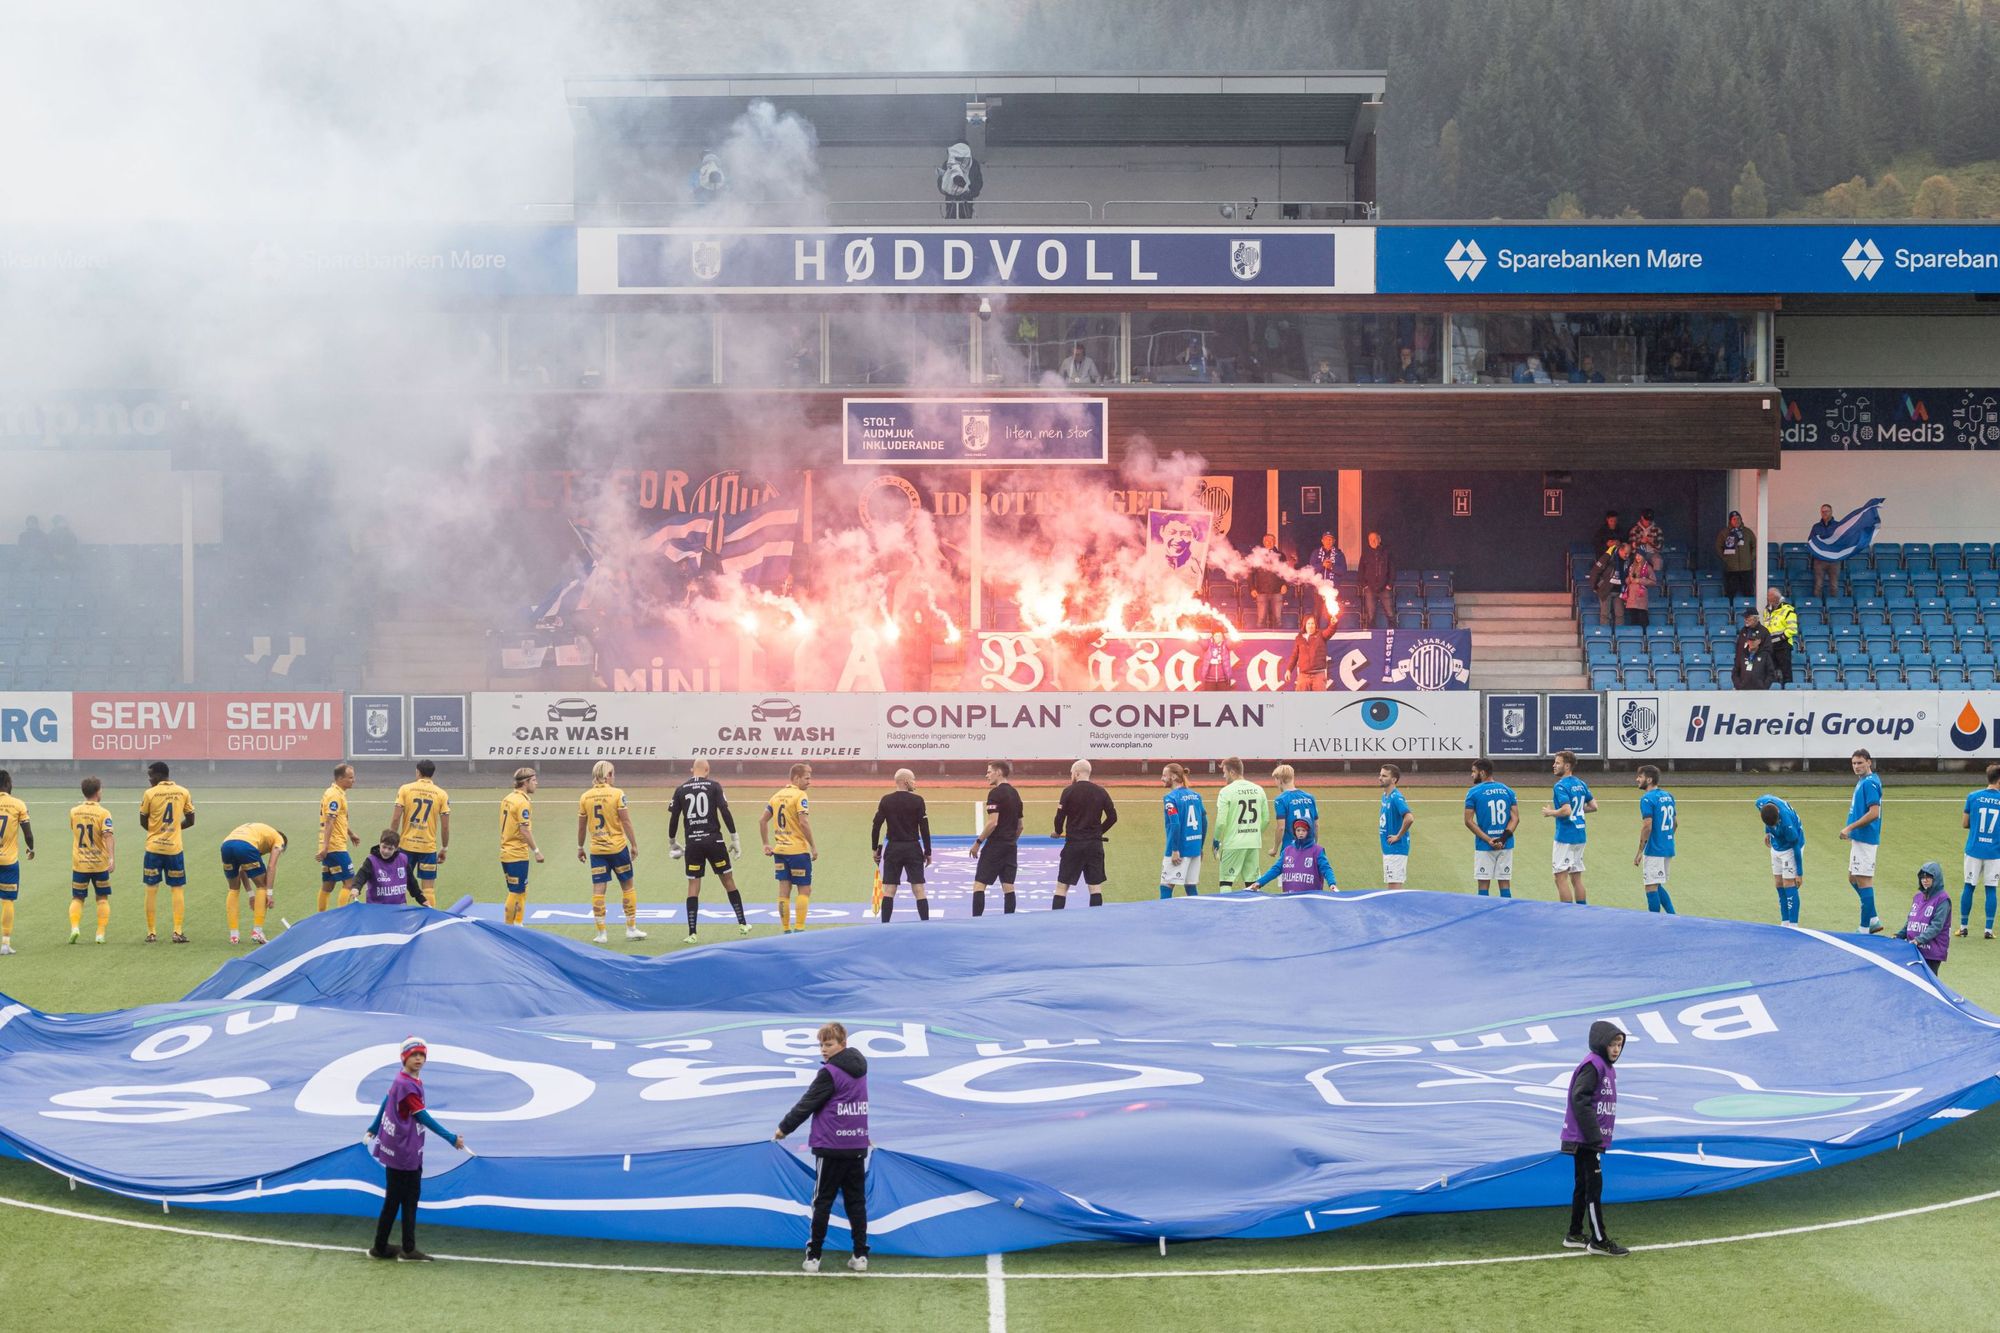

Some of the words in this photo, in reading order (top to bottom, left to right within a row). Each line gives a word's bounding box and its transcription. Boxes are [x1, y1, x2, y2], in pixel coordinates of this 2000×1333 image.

[449, 249, 507, 269] Møre
[794, 237, 1159, 283] HØDDVOLL
[1496, 247, 1641, 272] Sparebanken
[1646, 248, 1703, 269] Møre
[862, 416, 896, 427] STOLT
[1067, 425, 1093, 439] stor
[862, 428, 915, 438] AUDMJUK
[1877, 423, 1945, 443] Medi3
[862, 440, 945, 450] INKLUDERANDE
[90, 701, 196, 730] SERVI
[225, 701, 332, 730] SERVI
[1713, 712, 1814, 736] Hareid
[515, 726, 558, 741] CAR
[568, 726, 629, 741] WASH
[717, 726, 762, 742] CAR
[774, 726, 835, 742] WASH
[886, 732, 929, 741] Rådgivende
[930, 732, 966, 741] ingeniører
[968, 732, 987, 742] bygg
[1089, 731, 1132, 740] Rådgivende
[1133, 731, 1169, 740] ingeniører
[1171, 731, 1189, 741] bygg
[1292, 737, 1386, 752] HAVBLIKK
[1391, 736, 1464, 752] OPTIKK
[488, 746, 590, 756] PROFESJONELL
[597, 746, 657, 756] BILPLEIE
[691, 747, 794, 757] PROFESJONELL
[801, 747, 862, 757] BILPLEIE
[886, 741, 950, 751] www.conplan.no
[1089, 740, 1153, 750] www.conplan.no
[162, 802, 174, 825] 4
[410, 798, 434, 823] 27
[684, 791, 709, 819] 20
[1237, 799, 1258, 825] 25
[1487, 799, 1507, 826] 18
[1569, 795, 1586, 822] 24
[594, 804, 605, 830] 5
[777, 804, 787, 829] 6
[1186, 804, 1199, 831] 4
[1978, 807, 2000, 834] 17
[76, 823, 95, 848] 21
[835, 1129, 857, 1137] OBOS
